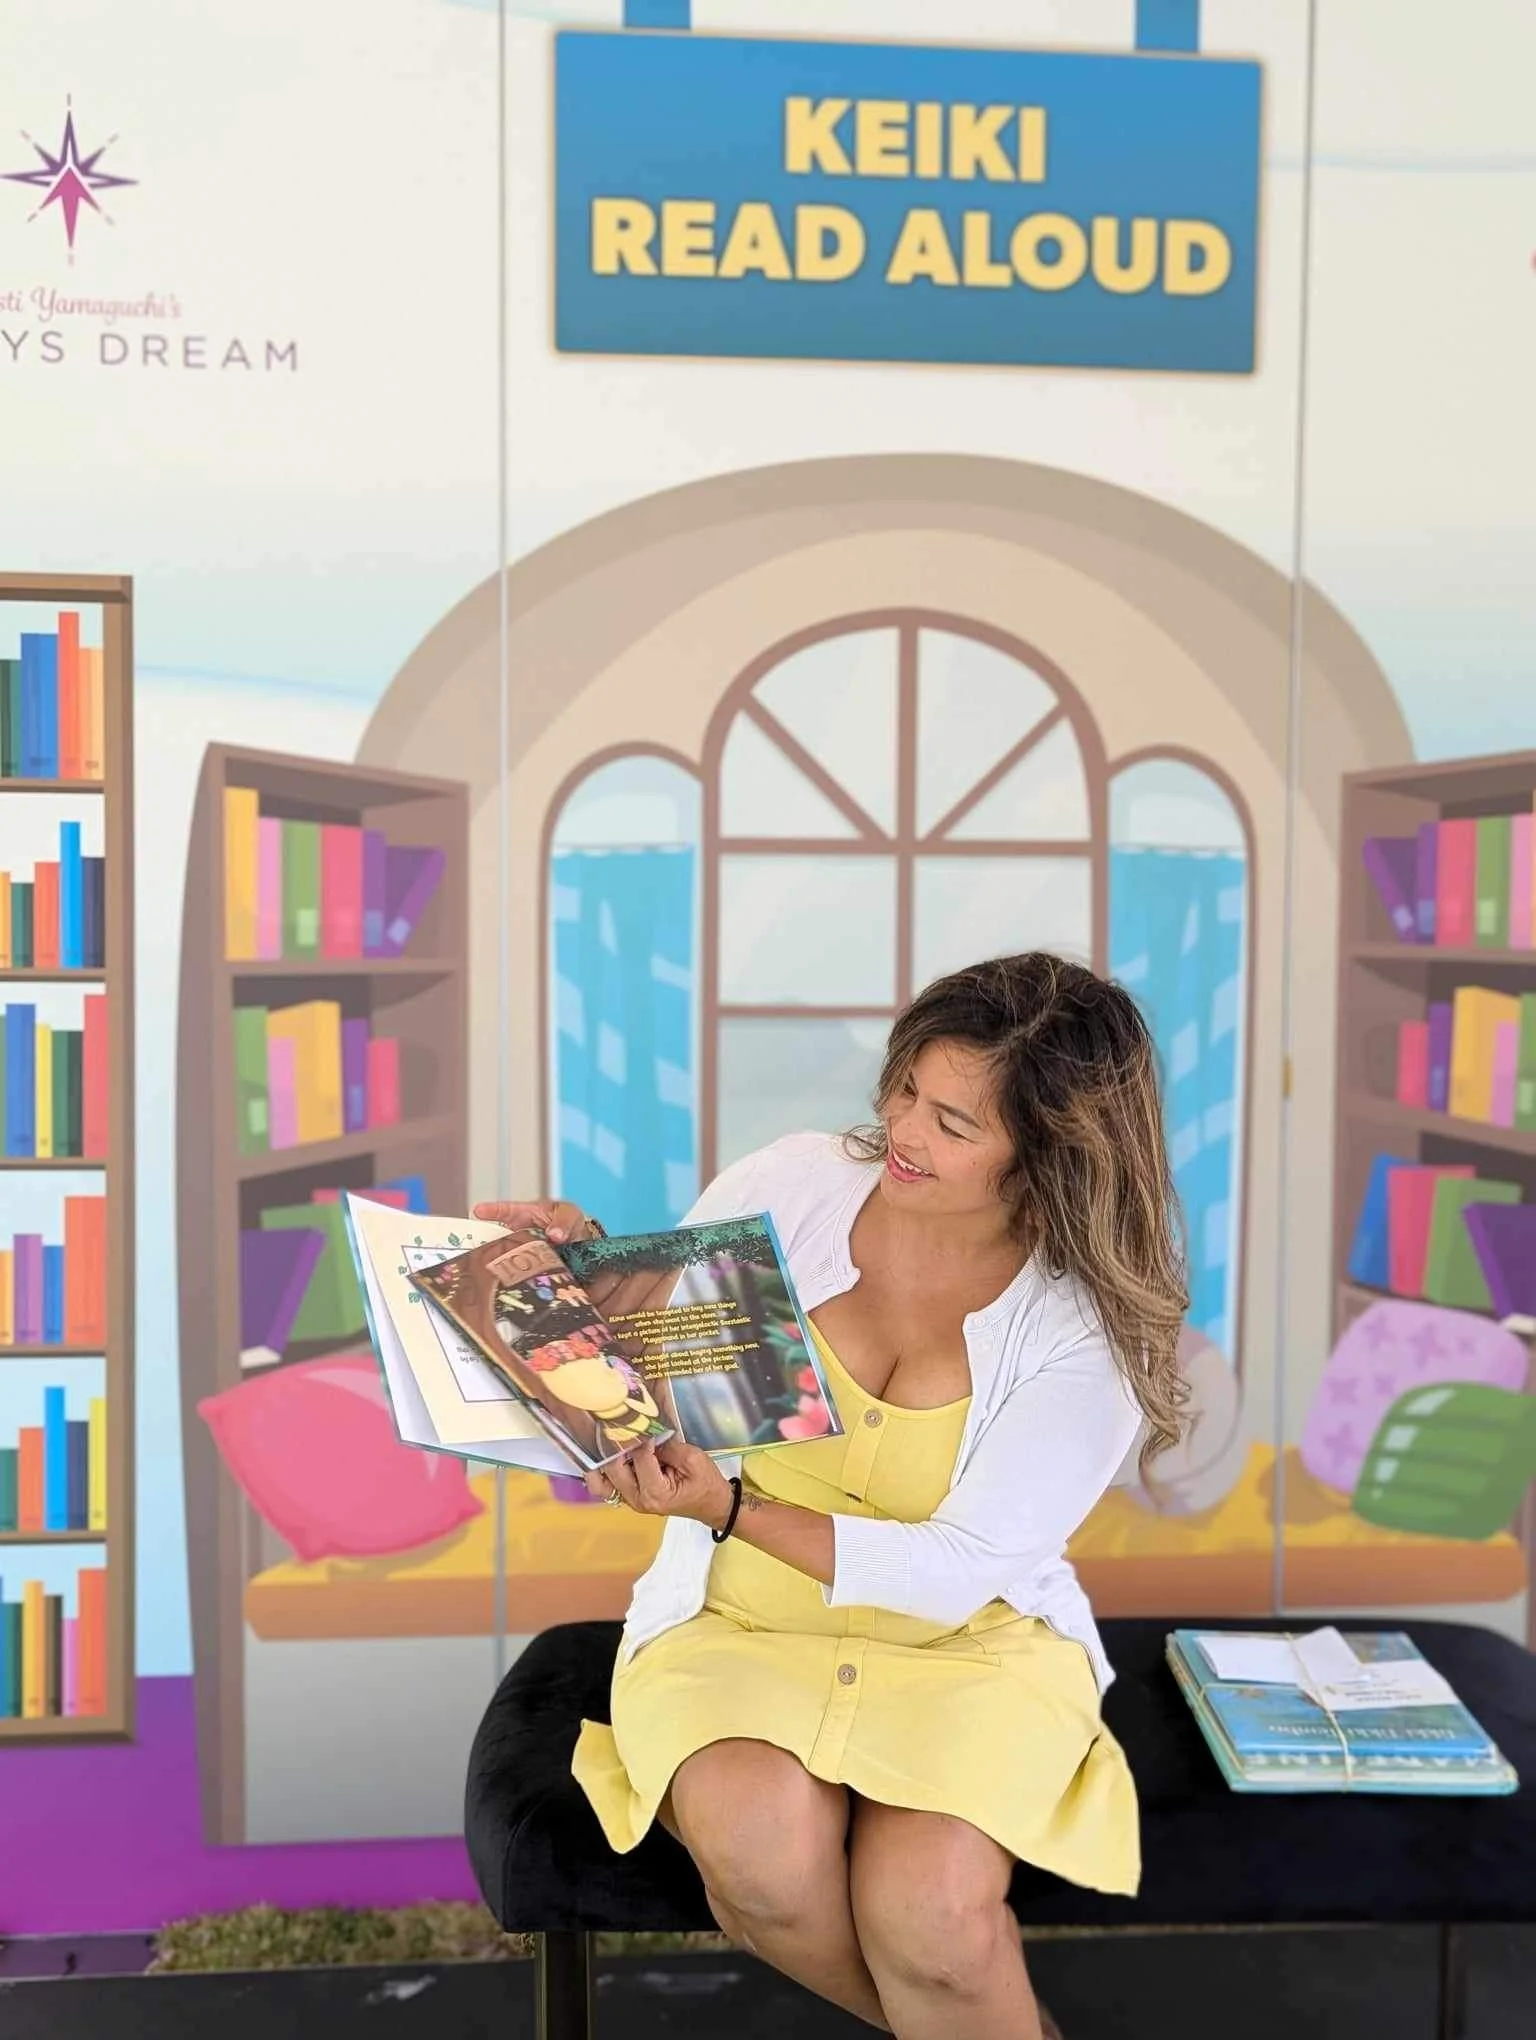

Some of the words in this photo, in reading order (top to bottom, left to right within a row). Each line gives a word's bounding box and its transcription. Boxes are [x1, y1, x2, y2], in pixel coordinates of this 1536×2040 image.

[785, 97, 1046, 182] KEIKI
[592, 198, 866, 282] READ
[885, 208, 1231, 296] ALOUD
[30, 286, 183, 325] Yamaguchi's
[1, 329, 65, 363] YS
[99, 332, 298, 372] DREAM
